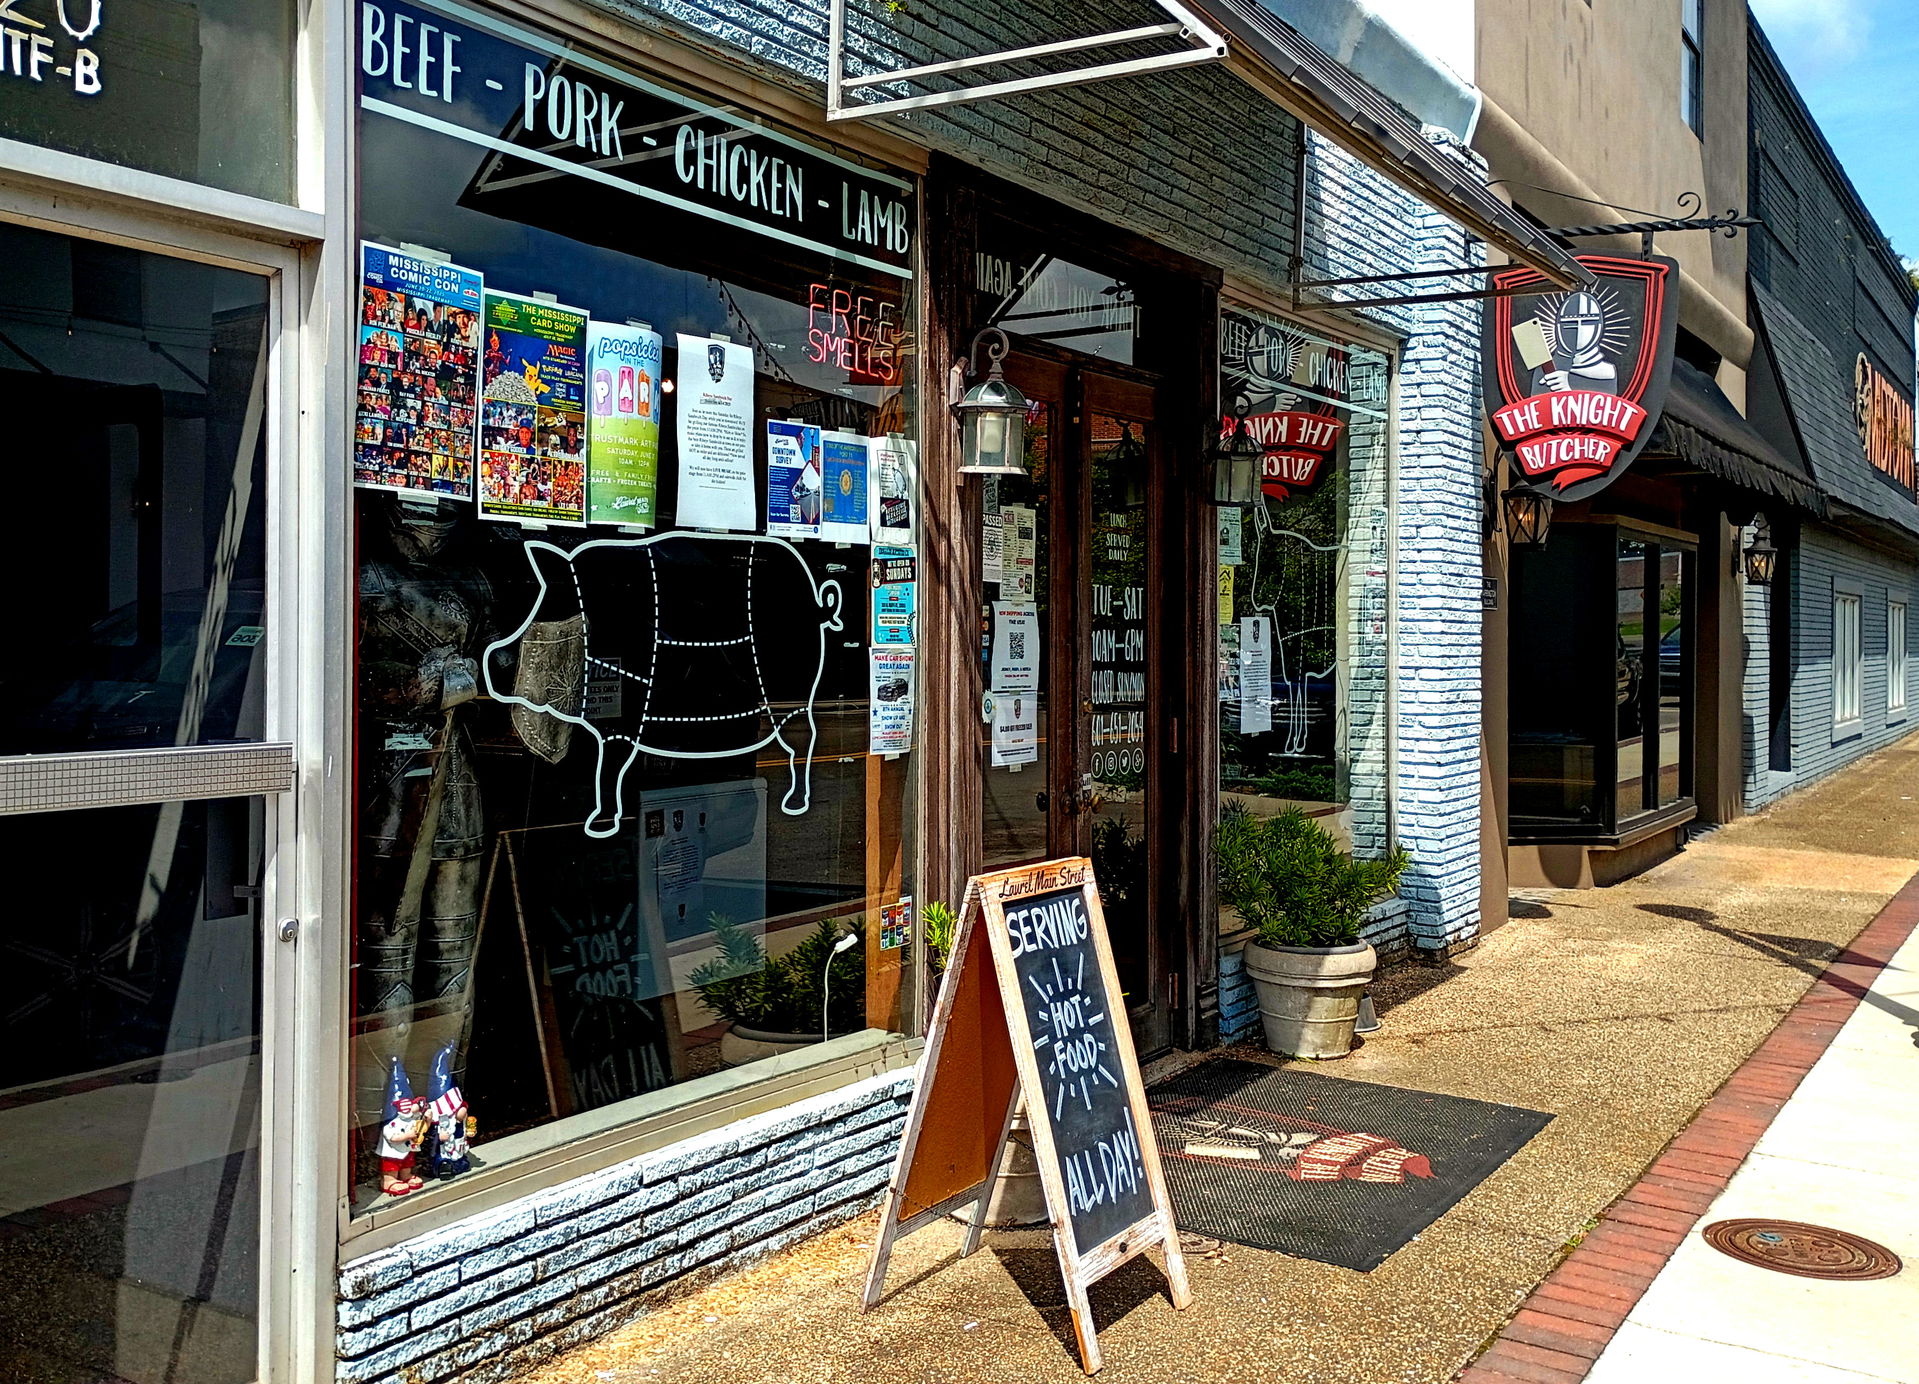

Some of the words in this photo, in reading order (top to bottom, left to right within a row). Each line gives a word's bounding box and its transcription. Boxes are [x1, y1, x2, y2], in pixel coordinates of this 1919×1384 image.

[362, 2, 461, 103] BEEF
[525, 62, 625, 161] PORK
[675, 124, 804, 222] CHICKEN
[842, 182, 909, 254] LAMB
[389, 255, 461, 283] MISSISSIPPI
[391, 267, 431, 286] COMIC
[435, 279, 459, 294] CON
[521, 304, 536, 314] THE
[538, 307, 584, 326] MISSISSIPPI
[530, 317, 552, 329] CARD
[554, 321, 576, 333] SHOW
[809, 284, 896, 348] FREE
[546, 344, 576, 357] MAGIC
[633, 358, 644, 367] THE
[808, 328, 894, 381] SMELLS
[1221, 317, 1248, 362] BEEF
[1309, 351, 1351, 395] CHICKEN
[1363, 366, 1388, 404] LAMB
[1496, 400, 1542, 436] THE
[1550, 394, 1638, 432] KNIGHT
[640, 439, 651, 448] ART
[772, 446, 796, 457] DOWNTOWN
[1522, 438, 1611, 470] BUTCHER
[618, 457, 633, 465] 10AM
[776, 456, 792, 465] SURVEY
[983, 514, 1002, 528] PASSED
[1110, 513, 1127, 527] LUNCH
[1105, 533, 1130, 547] SERVED
[1108, 549, 1128, 561] DAILY
[886, 567, 912, 580] SUNDAYS
[1091, 670, 1114, 704] CLOSED
[999, 872, 1033, 899] Laurel
[1035, 871, 1058, 895] Main
[1059, 865, 1086, 887] Street
[1006, 898, 1088, 960] SERVING
[1050, 995, 1084, 1038] HOT
[1054, 1033, 1097, 1079] FOOD
[1065, 1153, 1105, 1216] ALL
[1107, 1106, 1144, 1205] DAY!
